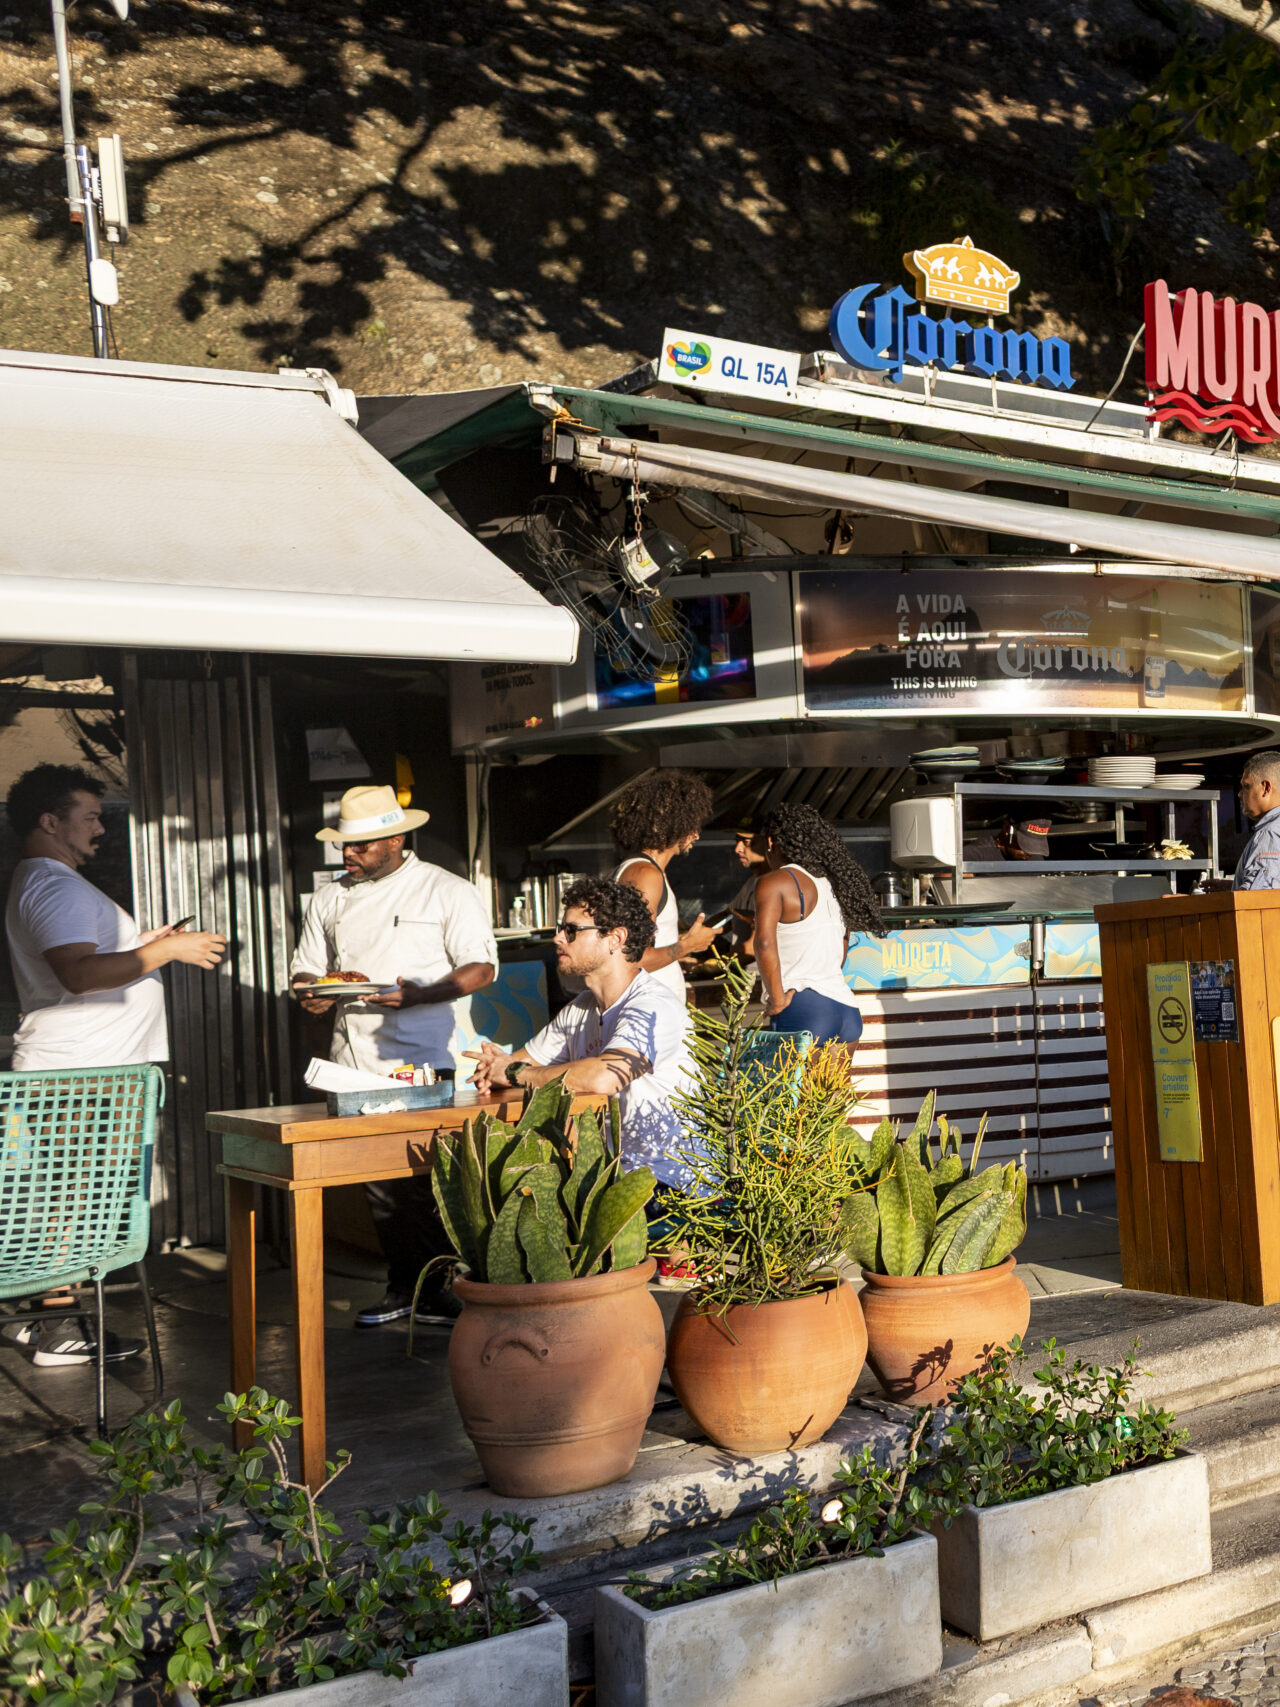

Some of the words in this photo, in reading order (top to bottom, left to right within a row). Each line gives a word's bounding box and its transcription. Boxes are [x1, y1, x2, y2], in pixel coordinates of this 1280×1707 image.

[829, 283, 1077, 391] Corona
[677, 353, 703, 366] BRASIL
[721, 355, 749, 381] QL
[756, 361, 789, 388] 15A
[896, 594, 910, 614] A
[916, 594, 967, 614] VIDA
[898, 616, 911, 642] É
[916, 621, 967, 643] AQUI
[906, 650, 961, 669] FORA
[997, 635, 1131, 683] Corona
[891, 677, 921, 690] THIS
[923, 676, 936, 689] IS
[937, 676, 978, 688] LIVING
[882, 941, 952, 972] MURETA
[1154, 973, 1182, 983] Proibido
[1155, 983, 1173, 992] fumar
[1161, 1072, 1188, 1082] Couvert
